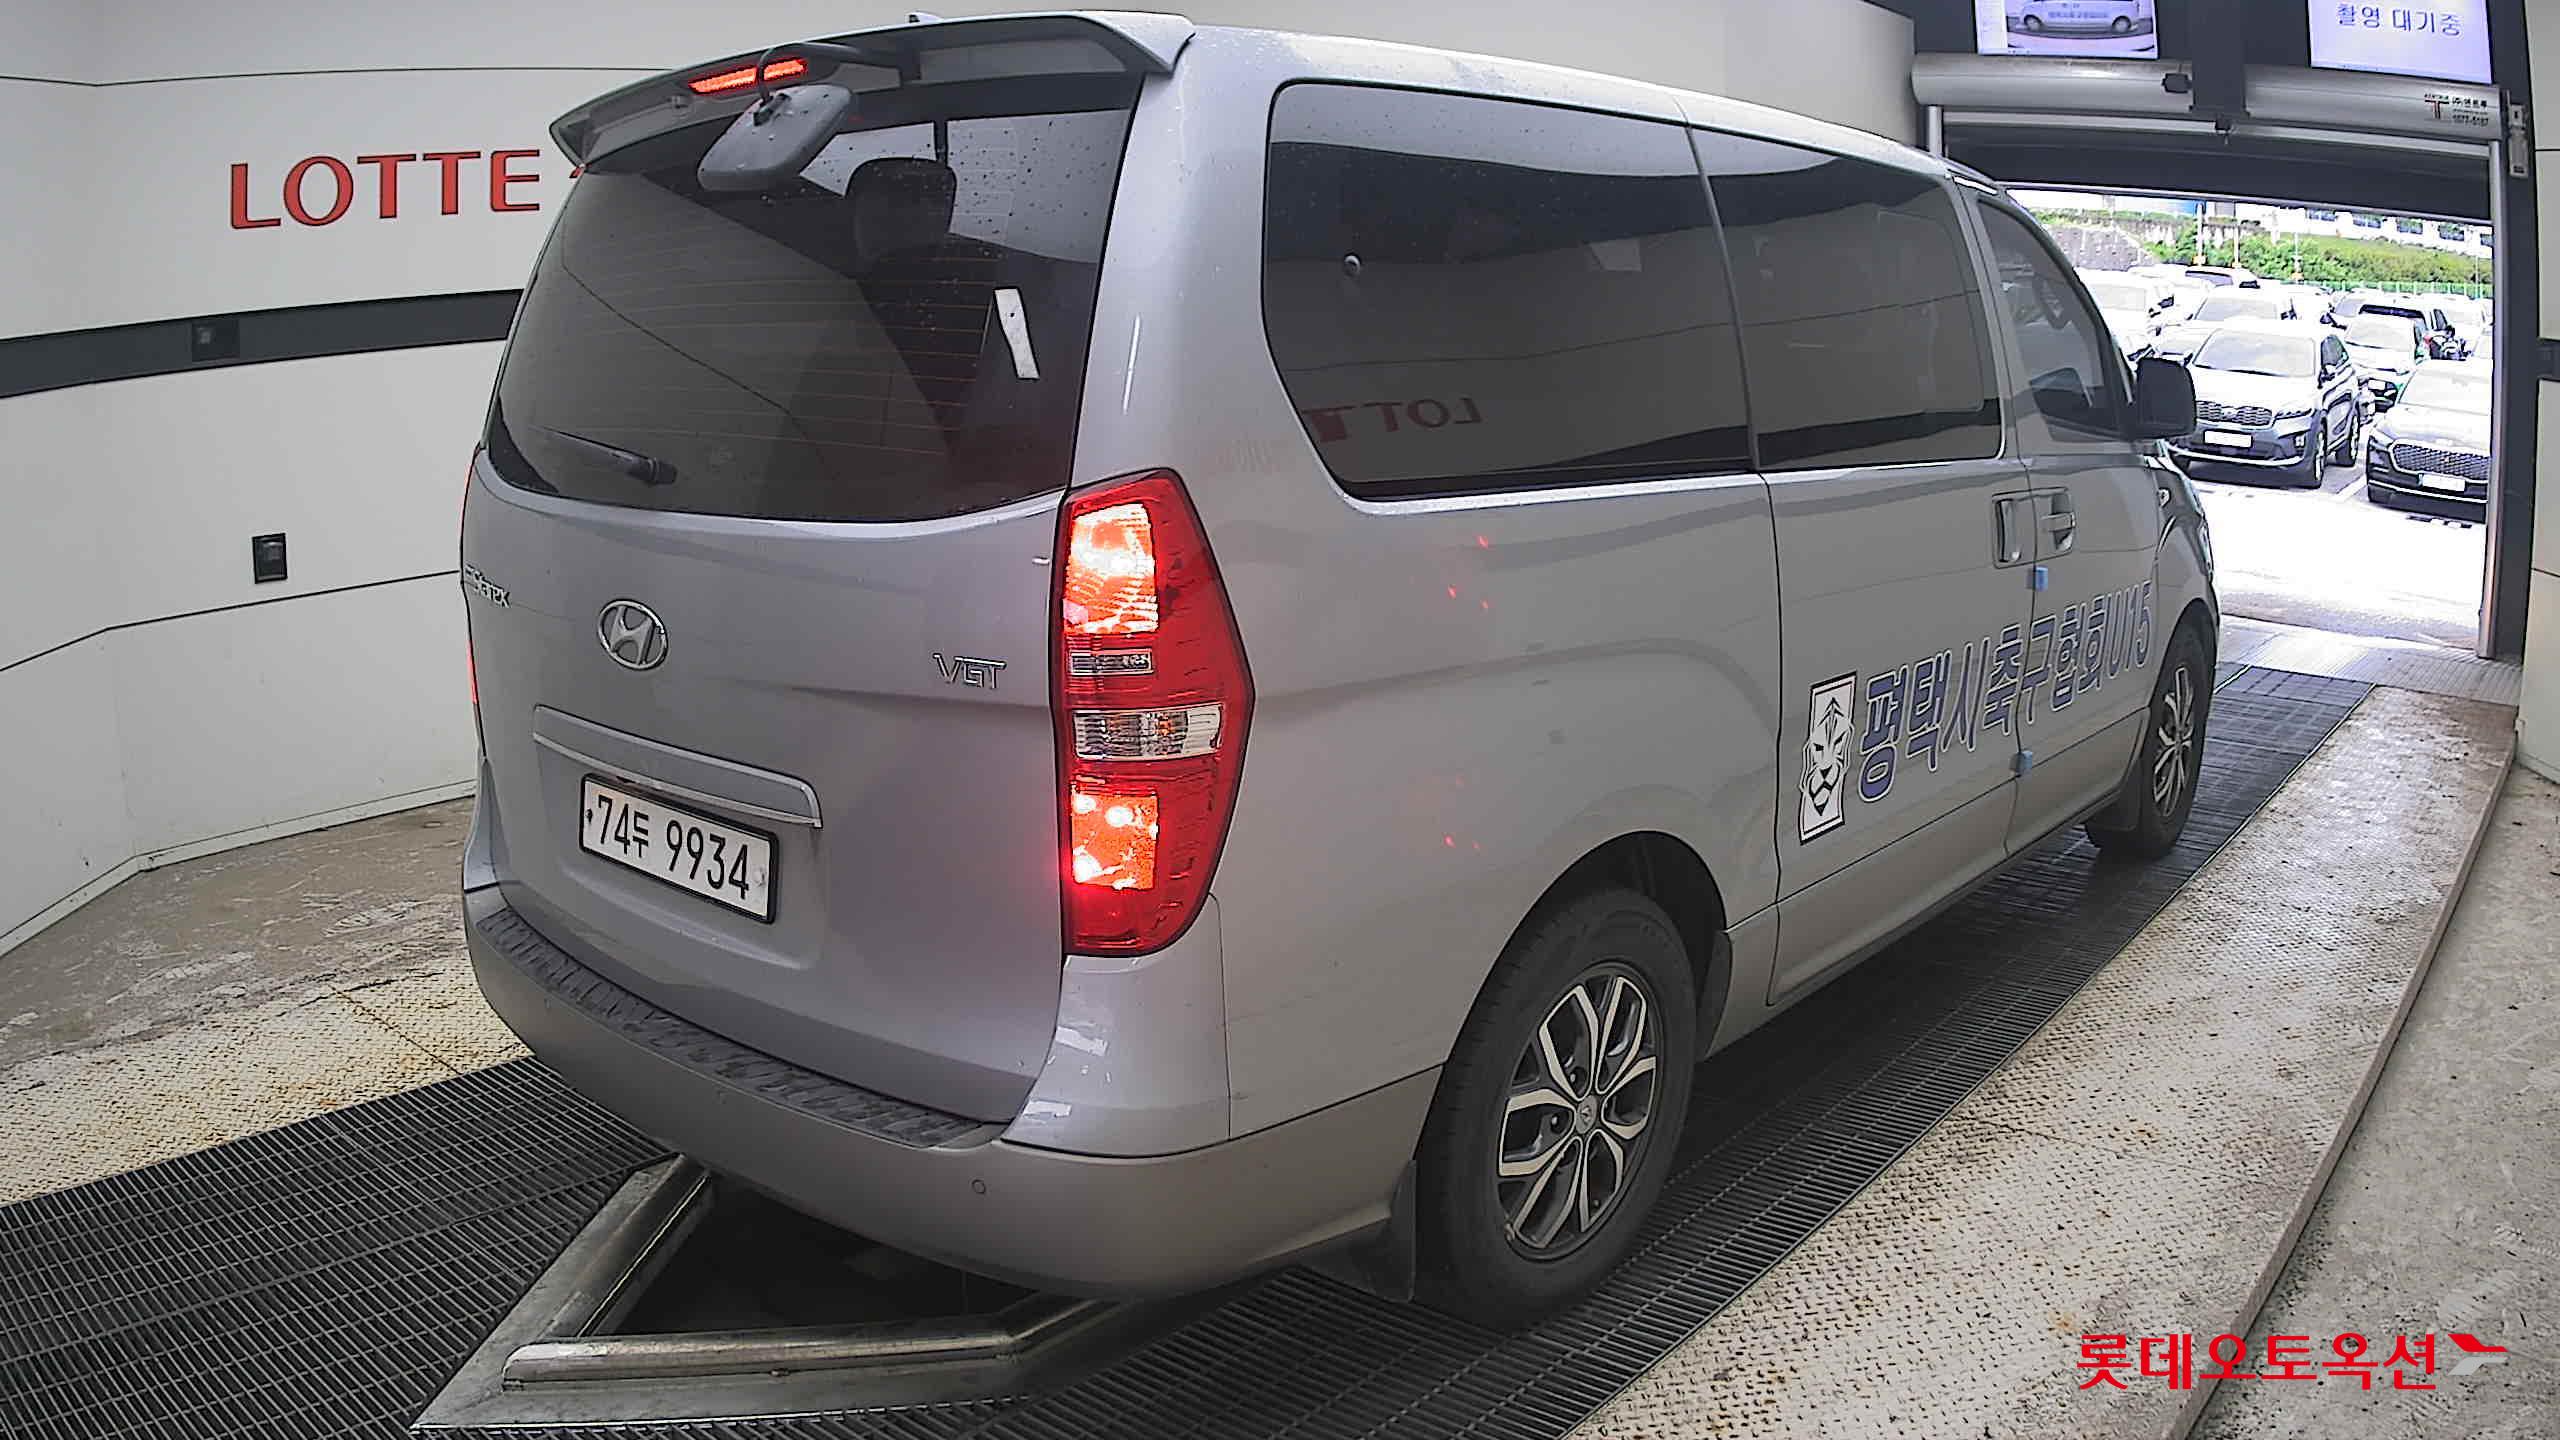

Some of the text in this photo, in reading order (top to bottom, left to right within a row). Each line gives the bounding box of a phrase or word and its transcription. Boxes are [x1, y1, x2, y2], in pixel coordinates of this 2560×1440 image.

[2337, 3, 2461, 37] 촬영 대기중
[230, 149, 541, 230] LOTTE
[933, 652, 1008, 689] VGT
[596, 794, 750, 900] 74두 9934
